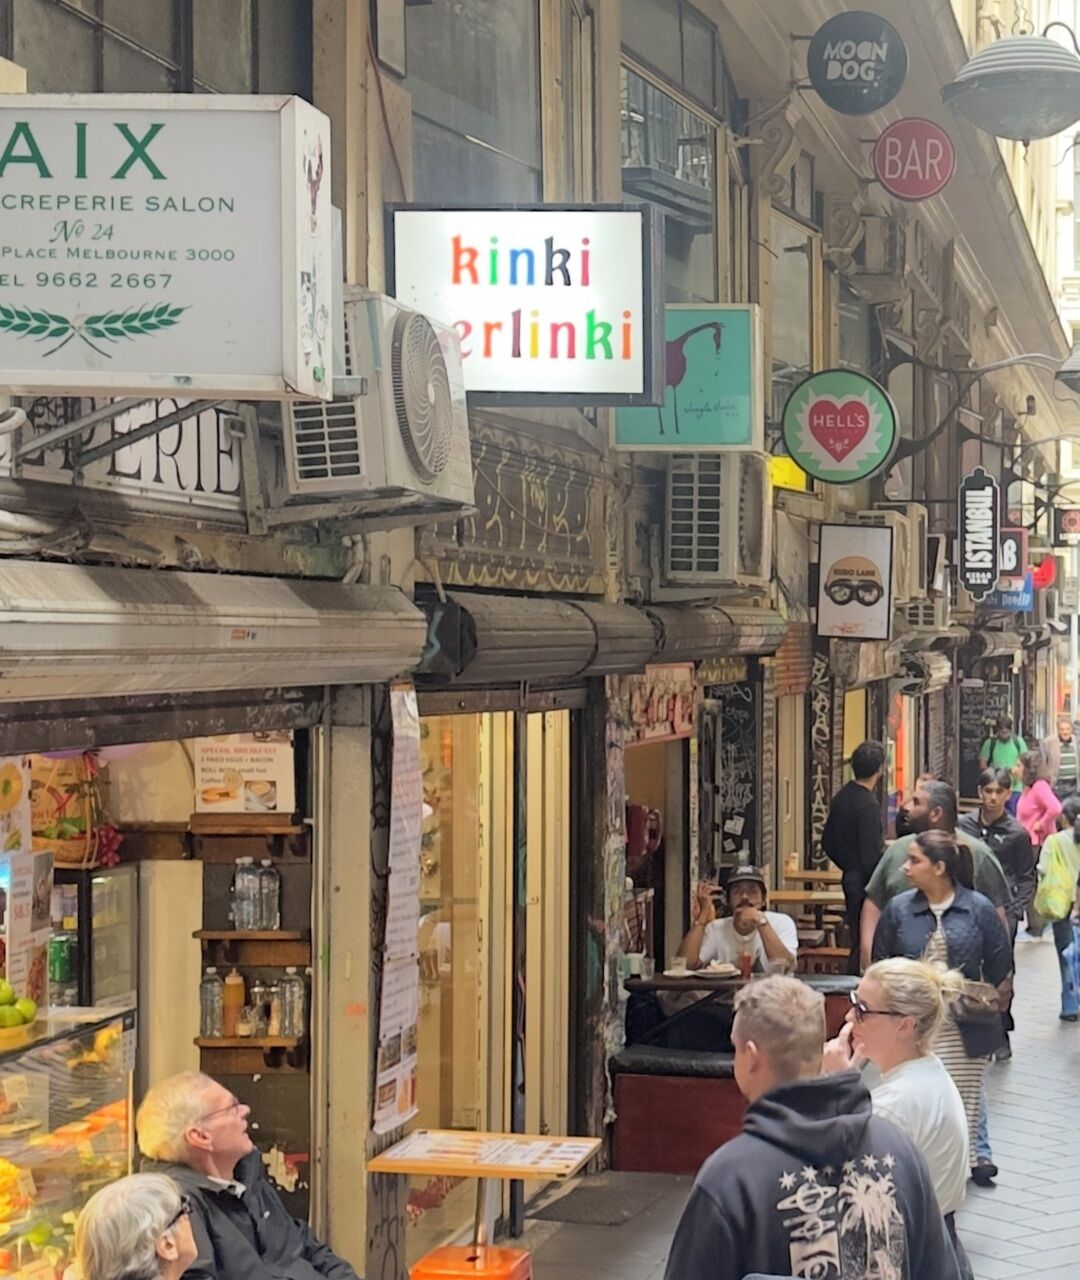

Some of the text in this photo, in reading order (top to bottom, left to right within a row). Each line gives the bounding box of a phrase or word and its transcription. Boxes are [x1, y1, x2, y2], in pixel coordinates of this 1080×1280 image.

[823, 39, 888, 62] MOON
[826, 60, 876, 81] DOG
[0, 121, 168, 180] AIX
[884, 137, 944, 181] BAR
[1, 194, 235, 213] CREPERIE SALON
[91, 222, 115, 241] 24
[185, 249, 236, 262] 3000
[451, 234, 590, 287] kinki
[35, 272, 99, 289] 9662
[109, 273, 173, 290] 2667
[451, 308, 632, 361] erlinki
[813, 413, 866, 428] HELL'S
[965, 486, 993, 569] ISTANBUL
